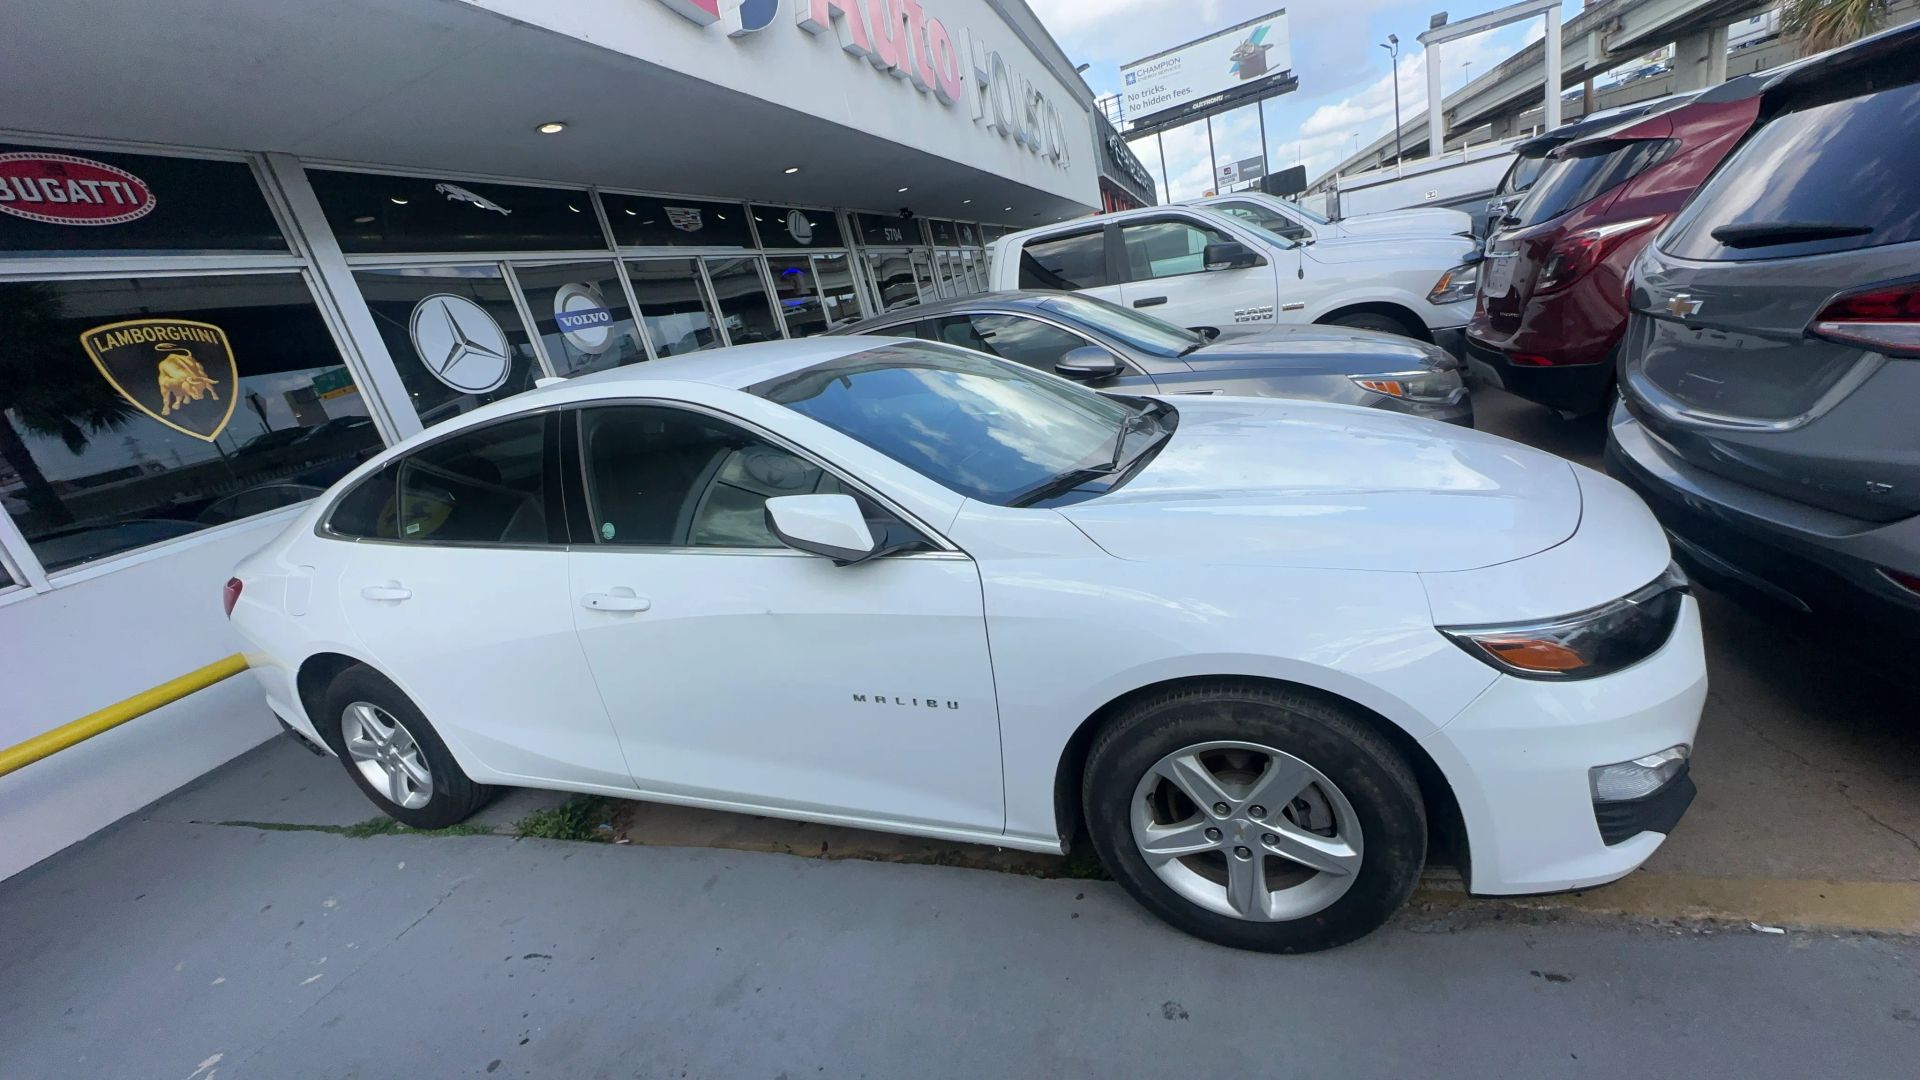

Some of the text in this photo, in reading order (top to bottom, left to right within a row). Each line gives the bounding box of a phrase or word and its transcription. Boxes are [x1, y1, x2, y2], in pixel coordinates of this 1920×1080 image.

[1136, 57, 1181, 77] CHAMPION
[957, 26, 1071, 170] HOUSTON
[1128, 85, 1167, 103] No tricks.
[1129, 87, 1193, 113] No hidden fees.
[0, 176, 138, 206] BUGATTI
[559, 311, 609, 327] VOLVO
[1234, 305, 1273, 317] RAM
[1234, 314, 1273, 323] 1500
[94, 326, 219, 353] LAMBORGHINI
[852, 693, 960, 710] MALIBU
